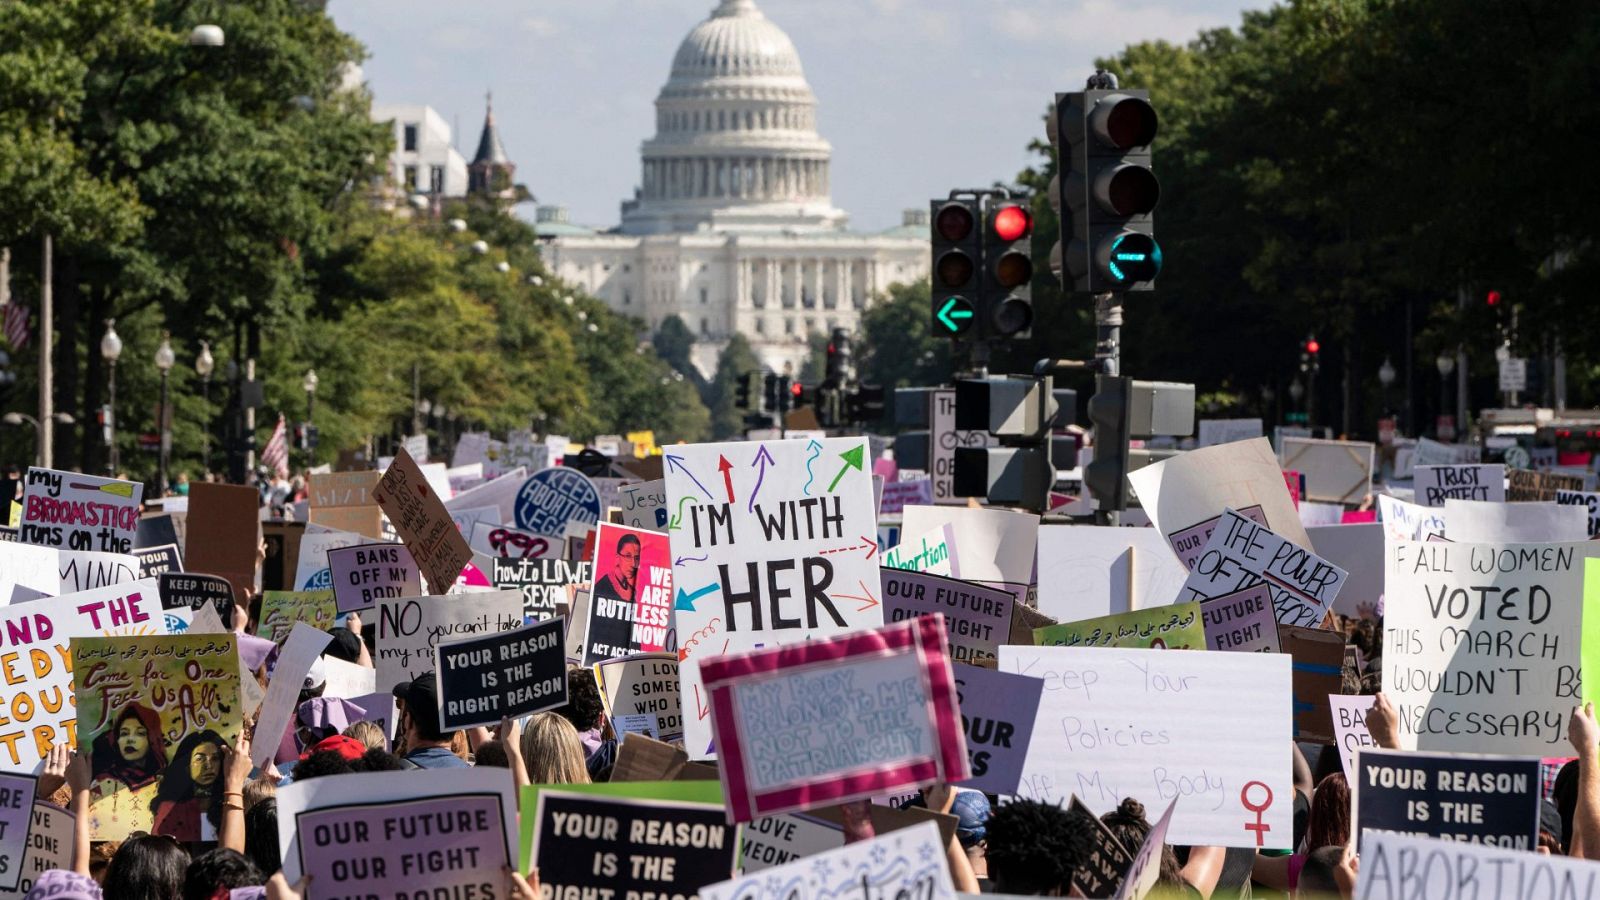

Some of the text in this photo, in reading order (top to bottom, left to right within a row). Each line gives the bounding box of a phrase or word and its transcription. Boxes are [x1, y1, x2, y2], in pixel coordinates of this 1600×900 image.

[29, 470, 62, 497] my
[546, 471, 597, 505] KEEP
[1430, 466, 1481, 486] TRUST
[522, 480, 598, 527] ABORTION
[624, 488, 666, 511] Jesu
[1426, 486, 1490, 506] PROTECT
[26, 494, 140, 531] BROOMSTICK
[520, 502, 568, 539] LEGA
[690, 502, 735, 548] I'M
[754, 496, 844, 541] WITH
[21, 524, 131, 553] runs on the
[140, 551, 169, 565] YOUR
[356, 548, 399, 566] BANS
[542, 559, 592, 584] LOWE
[1199, 549, 1241, 583] OF
[1223, 511, 1274, 561] THE
[1267, 541, 1338, 604] POWER
[1413, 546, 1453, 574] ALL
[1470, 545, 1574, 575] WOMEN
[169, 578, 229, 594] KEEP YOUR
[312, 569, 331, 587] KE
[350, 567, 408, 586] OFF MY
[650, 565, 672, 588] WE
[170, 595, 202, 607] LAWS
[362, 586, 403, 604] BODY
[641, 585, 671, 608] ARE
[717, 556, 849, 632] HER
[886, 580, 926, 601] OUR
[935, 588, 1004, 619] FUTURE
[1425, 584, 1552, 625] VOTED
[0, 592, 150, 647] ND THE
[380, 600, 422, 640] NO
[426, 622, 452, 646] you
[496, 613, 522, 632] take
[596, 597, 670, 627] RUTHLESS
[1201, 595, 1264, 628] FUTURE
[592, 643, 609, 655] ACT
[631, 624, 667, 647] NOW
[1216, 622, 1262, 650] FIGHT
[1388, 625, 1559, 660] THIS MARCH
[380, 648, 412, 668] my
[447, 651, 493, 671] YOUR
[500, 631, 558, 662] REASON
[81, 661, 133, 689] Come
[138, 660, 173, 688] for
[481, 662, 533, 688] IS THE
[641, 664, 645, 676] I
[1016, 656, 1200, 700] Keep Your
[1393, 664, 1529, 696] WOULDN'T
[448, 677, 562, 716] RIGHT REASON
[739, 669, 854, 712] MY BODY
[89, 682, 144, 736] Face
[152, 684, 176, 711] Us
[634, 699, 668, 714] WHO
[749, 708, 914, 760] NOT TO THE
[1061, 716, 1171, 751] Policies
[754, 727, 923, 787] PATRIARCHY
[1076, 770, 1119, 806] My
[1153, 766, 1225, 811] Body
[1366, 765, 1528, 794] YOUR REASON
[1407, 800, 1484, 825] IS THE
[314, 809, 490, 847] OUR FUTURE
[552, 812, 725, 850] YOUR REASON
[331, 846, 481, 882] OUR FIGHT
[593, 852, 677, 882] IS THE
